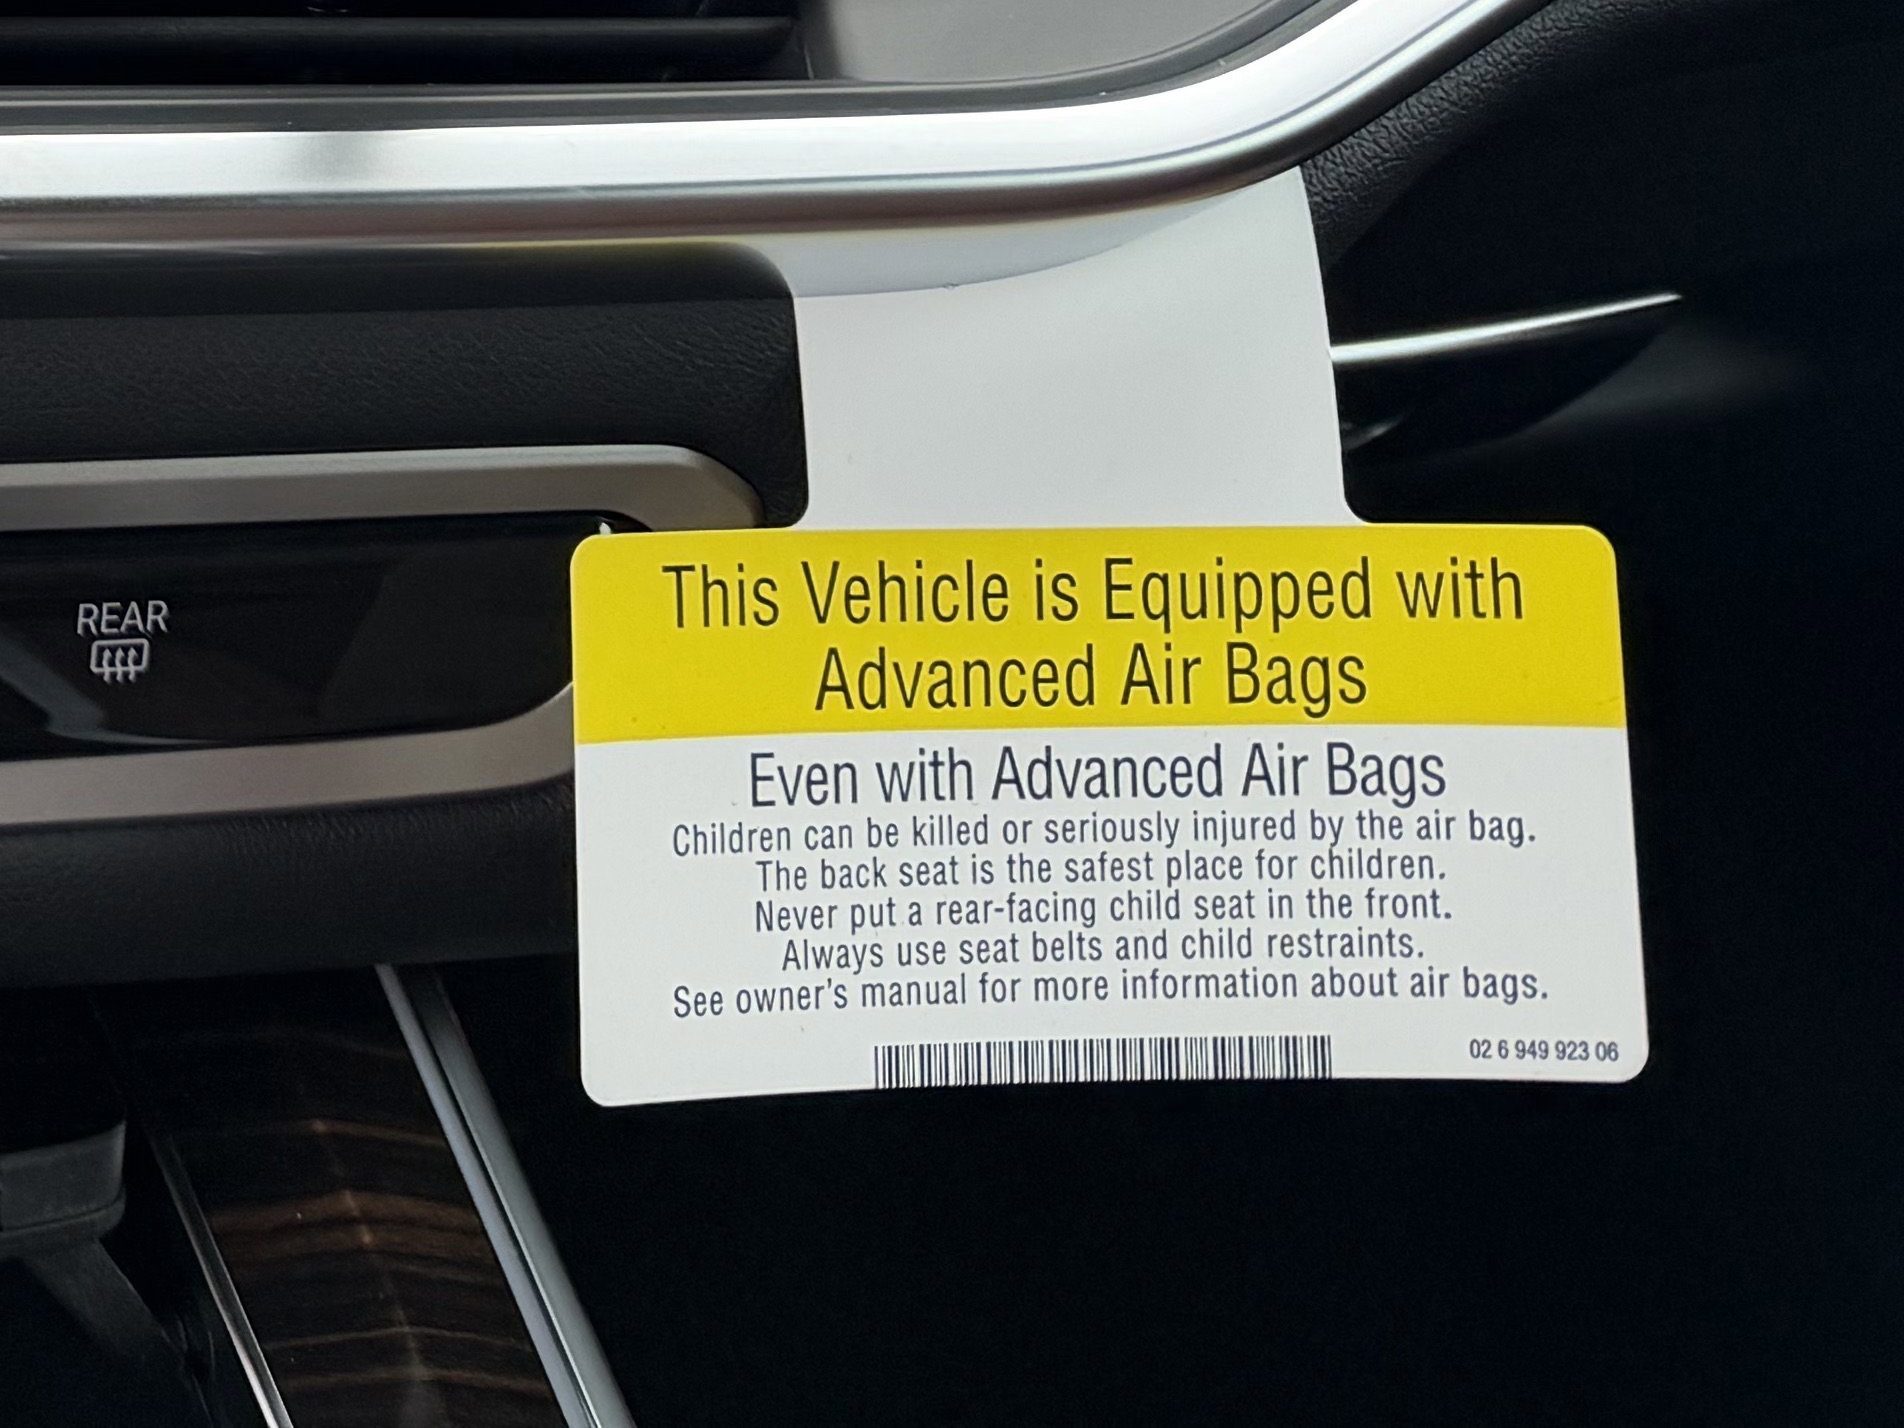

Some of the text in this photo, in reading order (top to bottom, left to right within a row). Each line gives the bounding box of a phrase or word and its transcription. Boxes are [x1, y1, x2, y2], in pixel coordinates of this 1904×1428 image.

[76, 600, 169, 637] REAR
[661, 555, 1523, 634] This Vehicle is Equipped with
[814, 641, 1367, 719] Advanced Air Bags
[750, 741, 1446, 809] Even with Advanced Air Bags
[673, 808, 1536, 857] Children can be killed or seriously injured by the air bag.
[755, 847, 1446, 892] The back seat is the safest place for children.
[755, 887, 1452, 936] Never put a rear-facing child seat in the front.
[781, 925, 1424, 976] Always use seat belts and child restraints.
[673, 965, 1548, 1018] See owner's manual for more information about air bags.
[1469, 1039, 1619, 1061] 02 6 949 923 06
